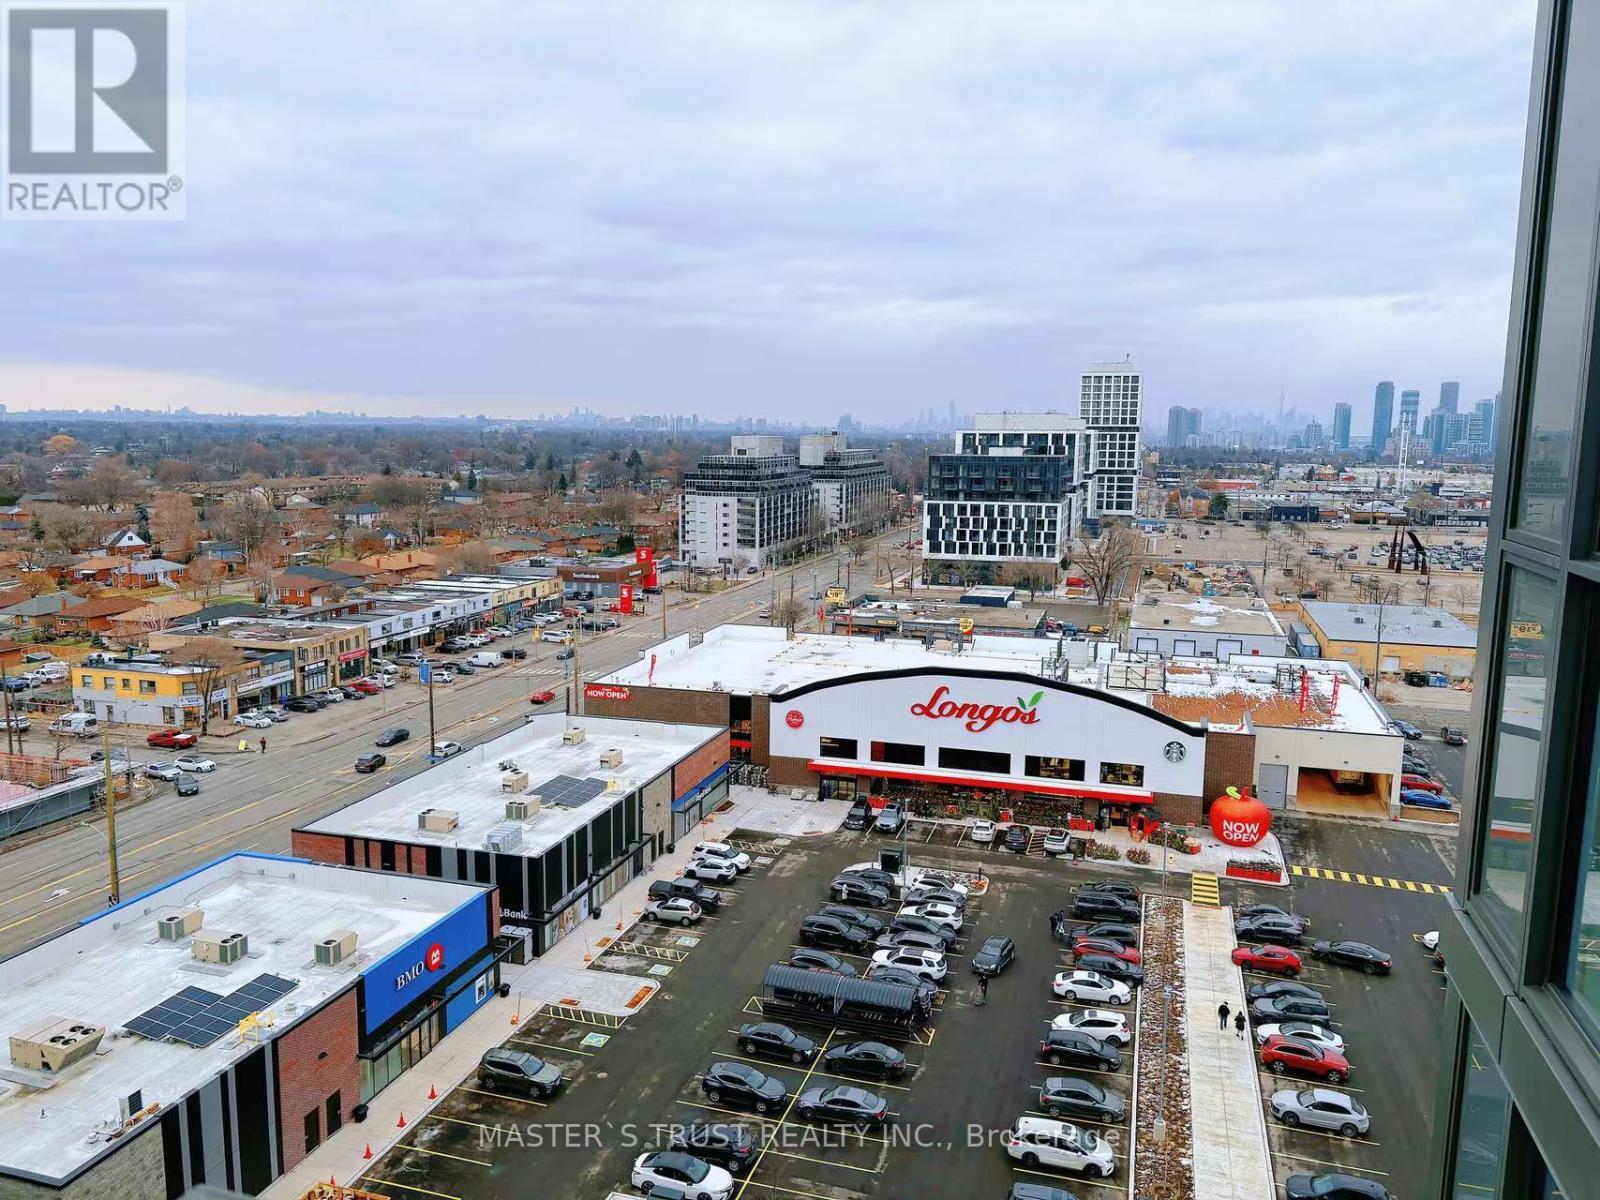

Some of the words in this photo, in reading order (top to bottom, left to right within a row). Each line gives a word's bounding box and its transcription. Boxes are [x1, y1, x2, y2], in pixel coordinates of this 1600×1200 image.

[606, 691, 627, 699] OPEN
[1223, 820, 1260, 834] NOW
[1223, 831, 1259, 842] OPEN
[396, 961, 425, 991] BMO
